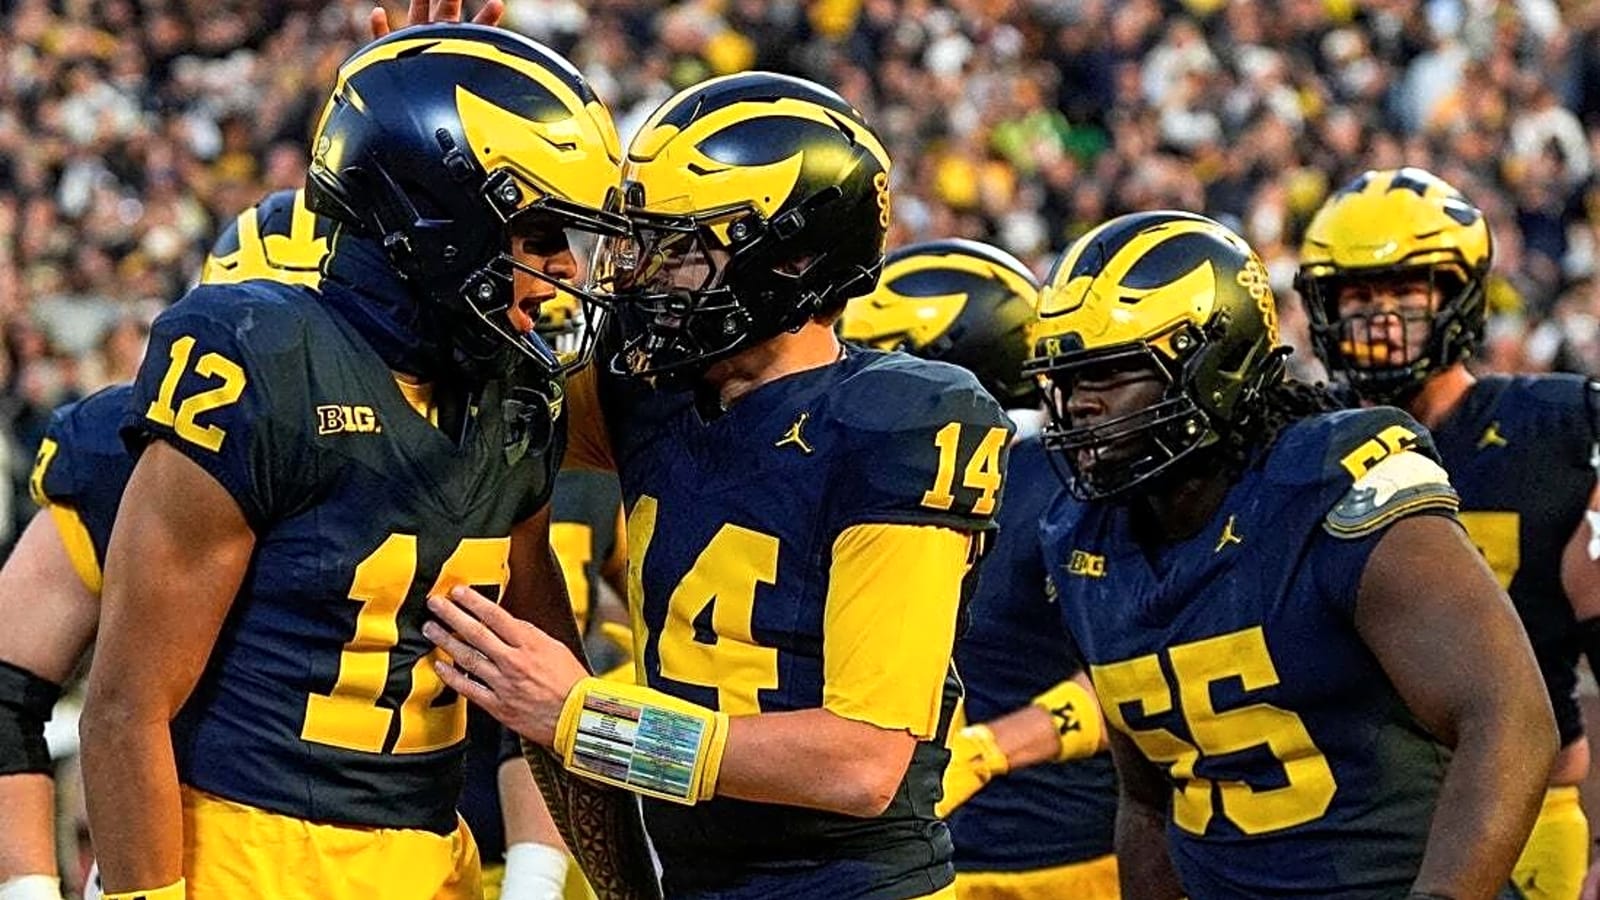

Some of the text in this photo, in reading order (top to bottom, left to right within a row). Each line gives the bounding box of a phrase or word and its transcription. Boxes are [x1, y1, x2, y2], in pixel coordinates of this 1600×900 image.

[146, 336, 247, 452] 12
[921, 422, 1008, 514] 14
[300, 533, 511, 755] 12
[1090, 625, 1337, 836] 55
